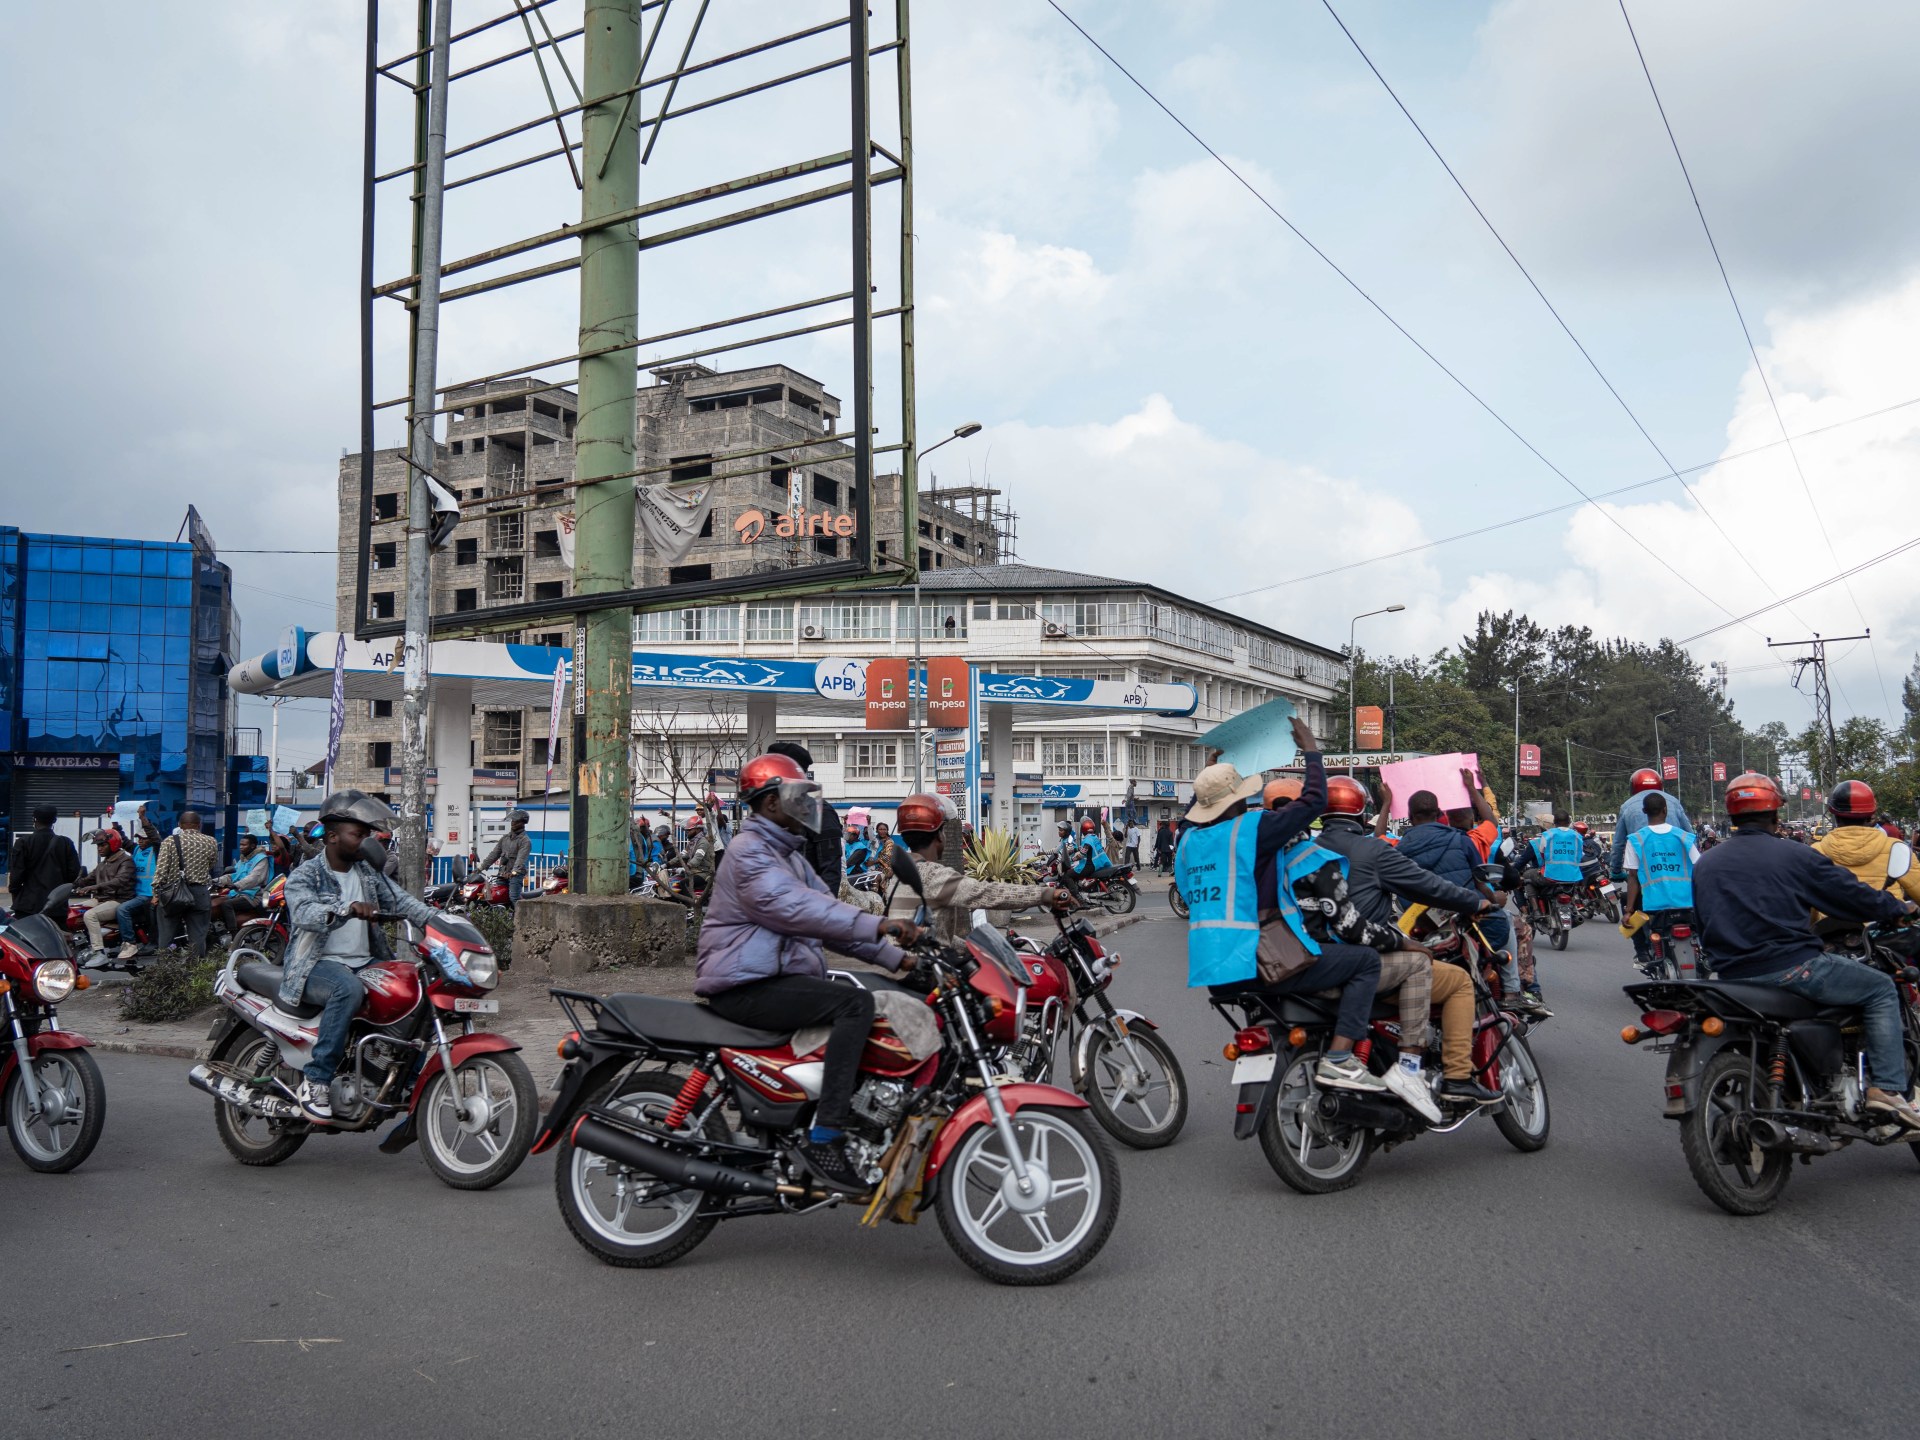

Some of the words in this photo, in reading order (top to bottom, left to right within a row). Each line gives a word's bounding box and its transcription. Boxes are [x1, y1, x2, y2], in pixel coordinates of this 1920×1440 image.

[661, 676, 738, 685] BUSINESS
[821, 676, 854, 690] APB
[1124, 694, 1141, 705] APB
[868, 700, 906, 711] m-pesa
[930, 700, 966, 710] m-pesa
[34, 757, 101, 767] MATELAS
[938, 758, 948, 766] TYRE
[949, 756, 965, 765] CENTRE
[1324, 757, 1360, 767] JAMBO
[1366, 755, 1404, 766] SAFARI
[1650, 863, 1680, 873] 00397
